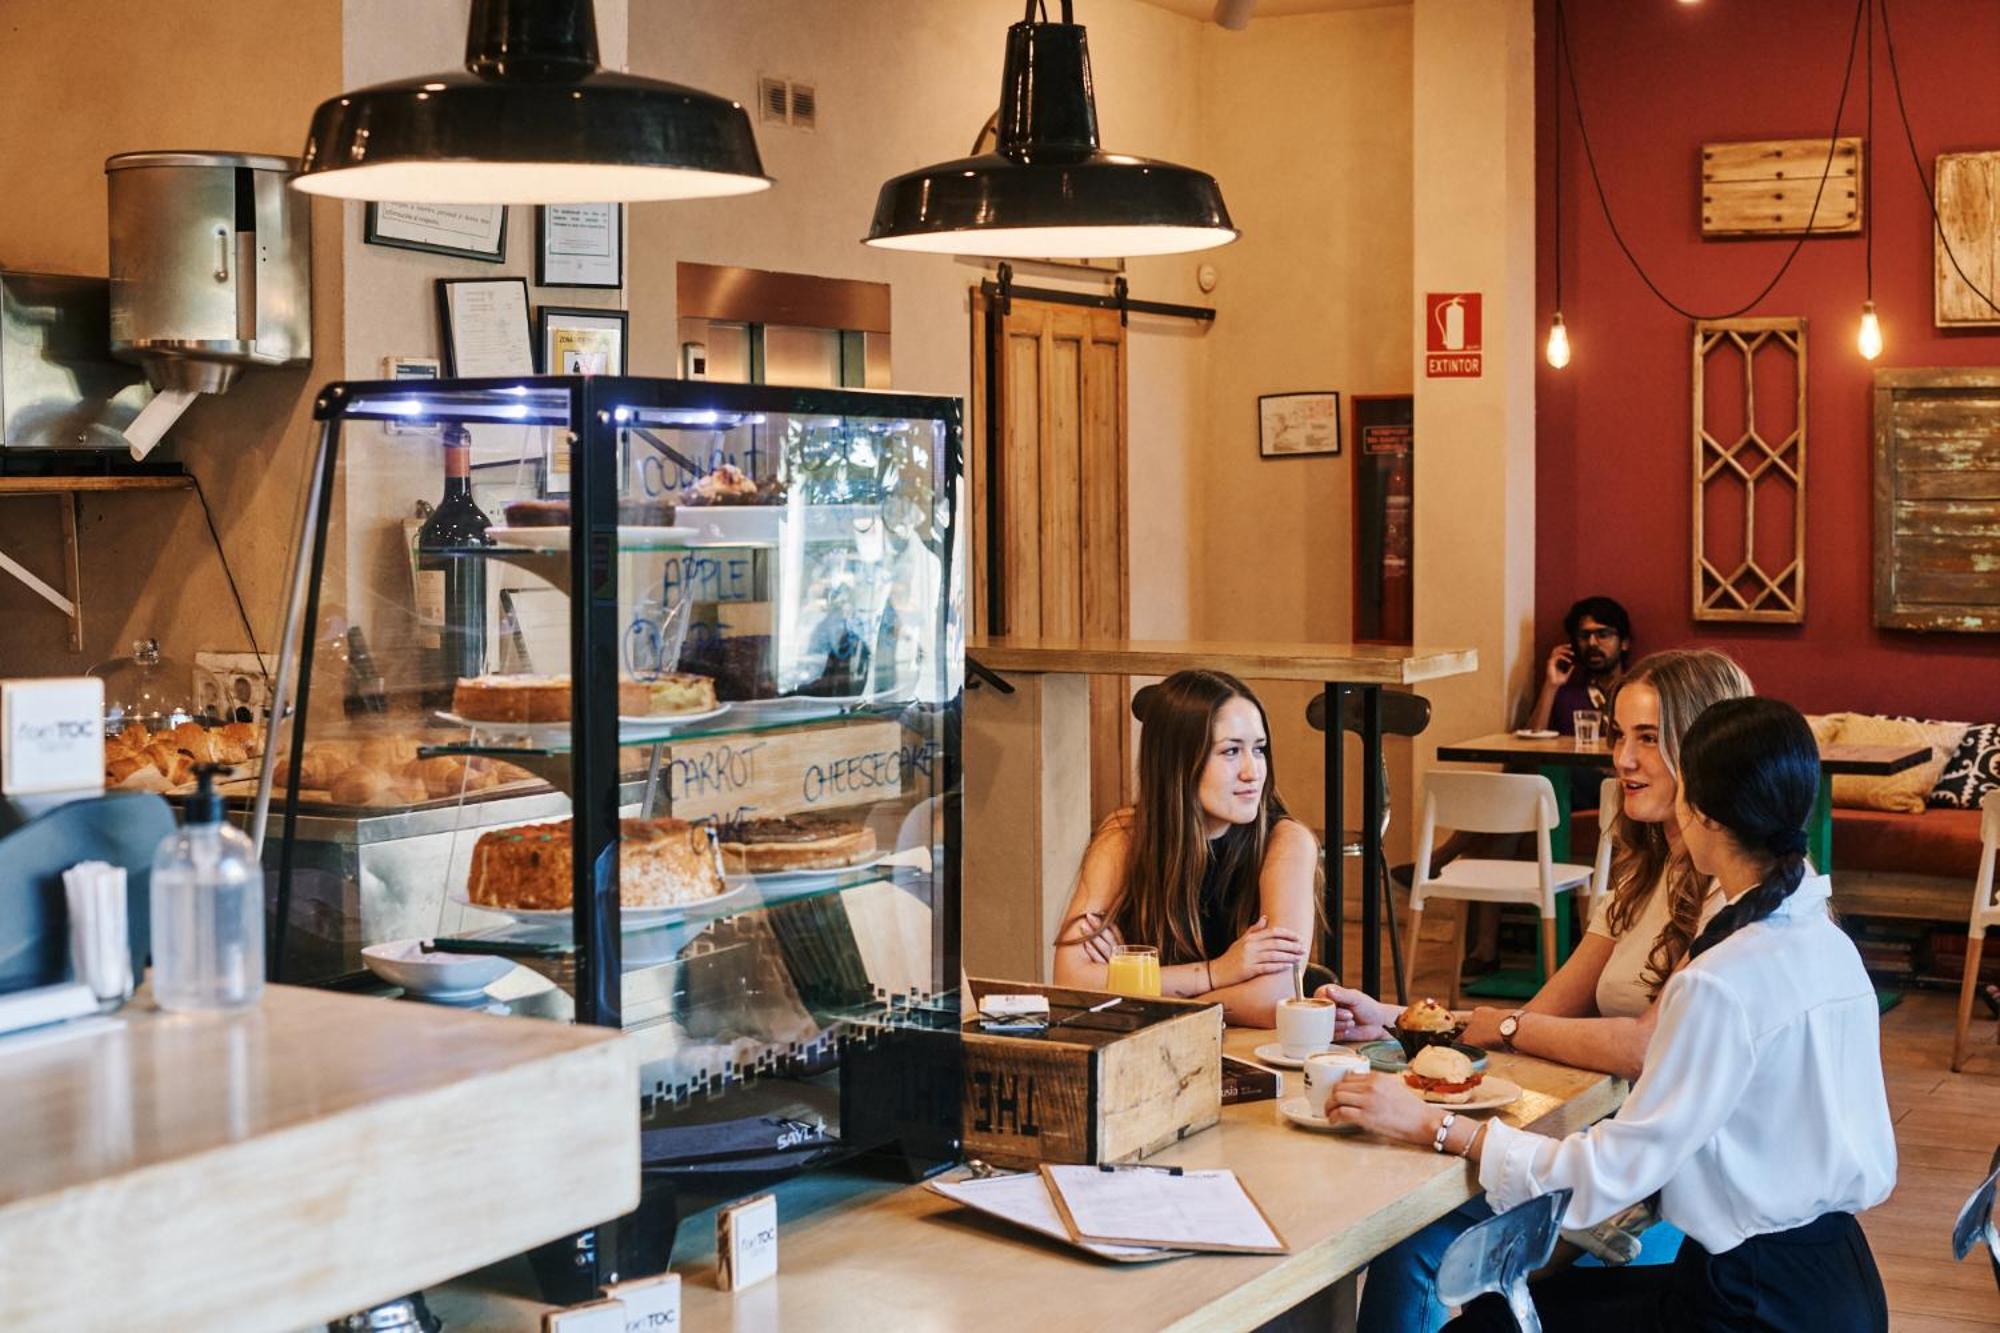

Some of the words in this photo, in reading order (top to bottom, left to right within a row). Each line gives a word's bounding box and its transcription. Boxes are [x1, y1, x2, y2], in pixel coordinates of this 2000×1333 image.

[1429, 359, 1480, 373] EXTINTOR
[661, 557, 749, 607] APPLE
[667, 742, 767, 801] CARROT
[803, 742, 940, 803] CHEESECAKE
[974, 1071, 1040, 1138] THE
